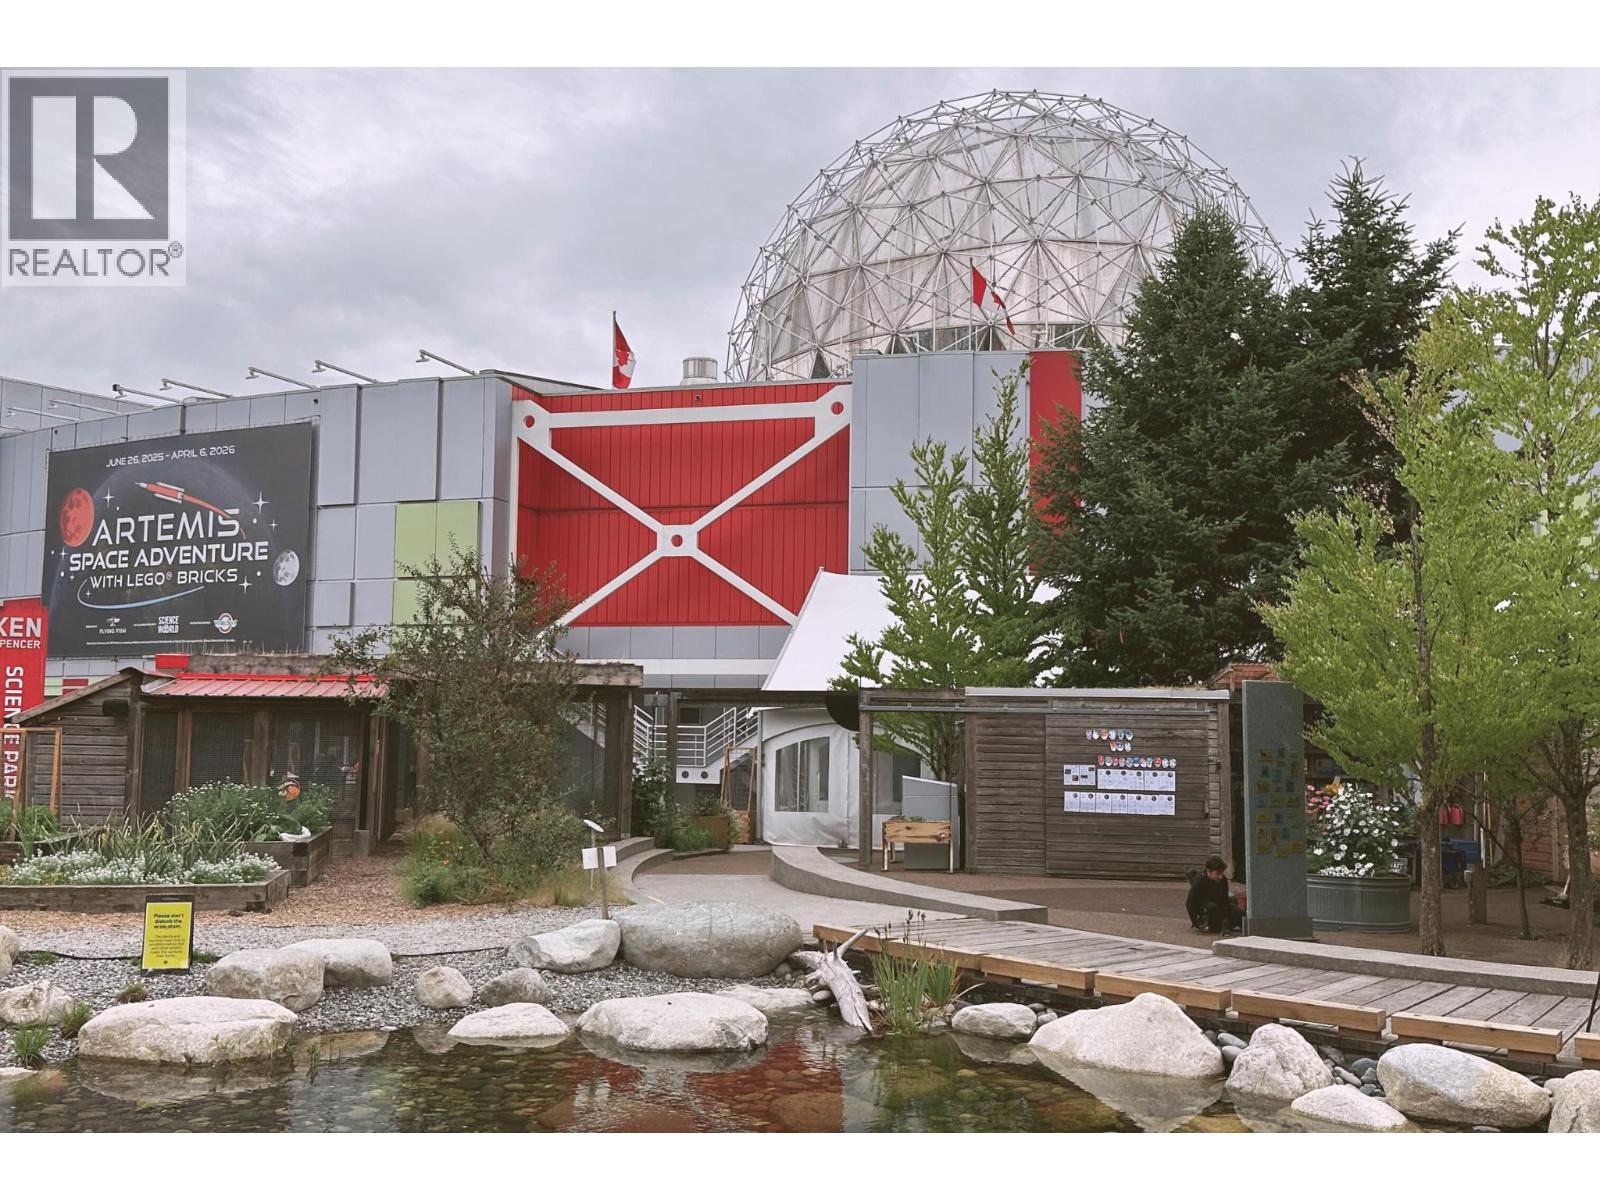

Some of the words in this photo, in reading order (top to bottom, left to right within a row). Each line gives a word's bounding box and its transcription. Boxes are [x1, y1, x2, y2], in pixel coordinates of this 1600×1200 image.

[106, 457, 126, 468] JUNE
[141, 452, 164, 463] 2025
[171, 449, 198, 460] APRIL
[199, 447, 208, 458] 6,
[209, 445, 236, 456] 2026
[92, 508, 240, 546] ARTEMIS
[69, 550, 129, 571] SPACE
[134, 541, 269, 568] ADVENTURE
[90, 575, 123, 589] WITH
[177, 568, 238, 584] BRICKS
[158, 615, 179, 625] SCIENCE
